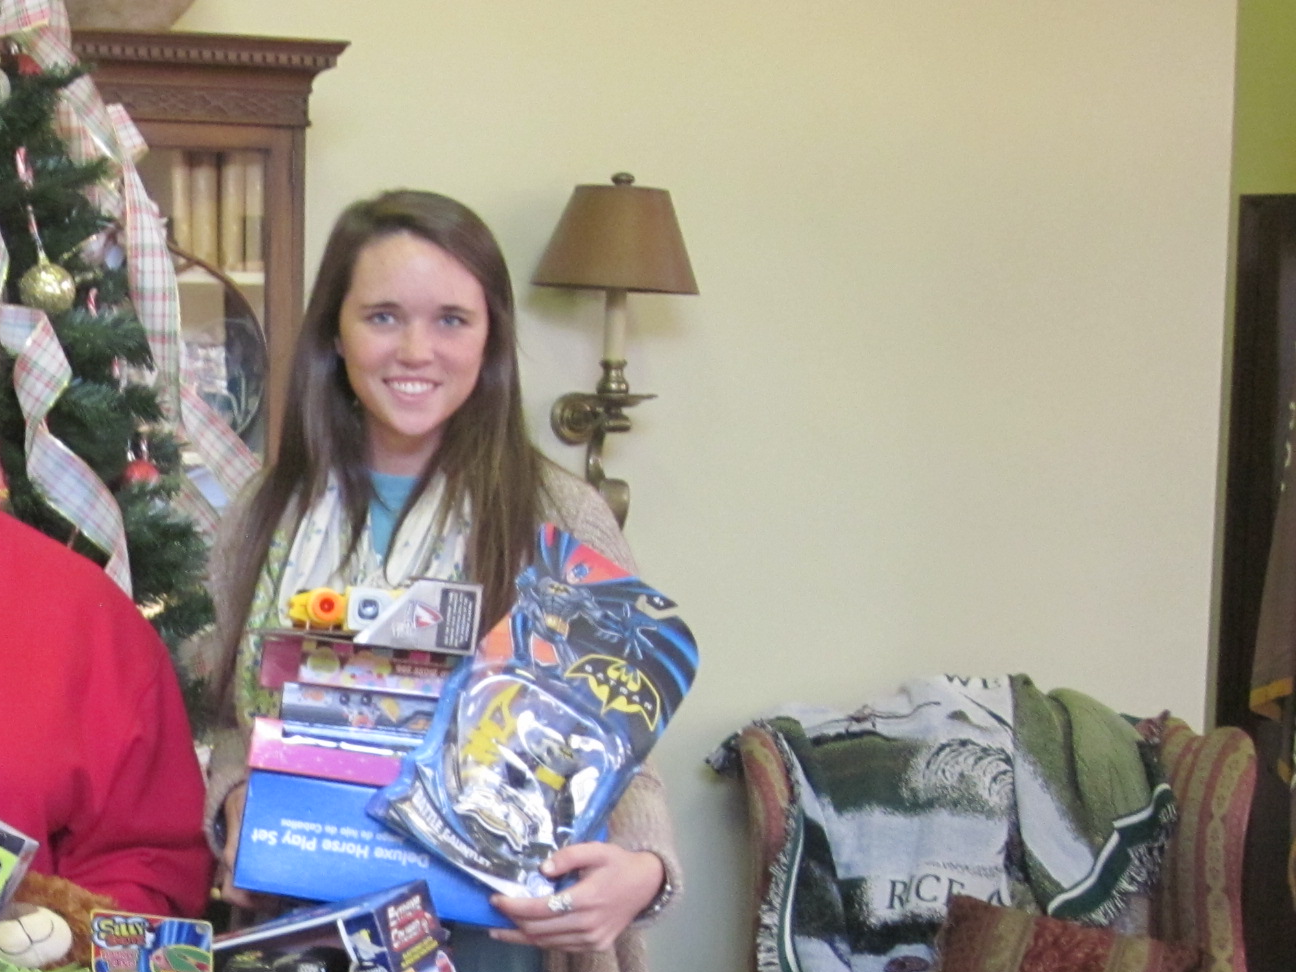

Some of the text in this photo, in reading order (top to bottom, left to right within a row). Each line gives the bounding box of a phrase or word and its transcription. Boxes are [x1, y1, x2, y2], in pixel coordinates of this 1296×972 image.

[584, 664, 653, 711] BATMAN
[250, 827, 430, 869] Deluxe Horse Play Set
[98, 918, 145, 937] SILLY
